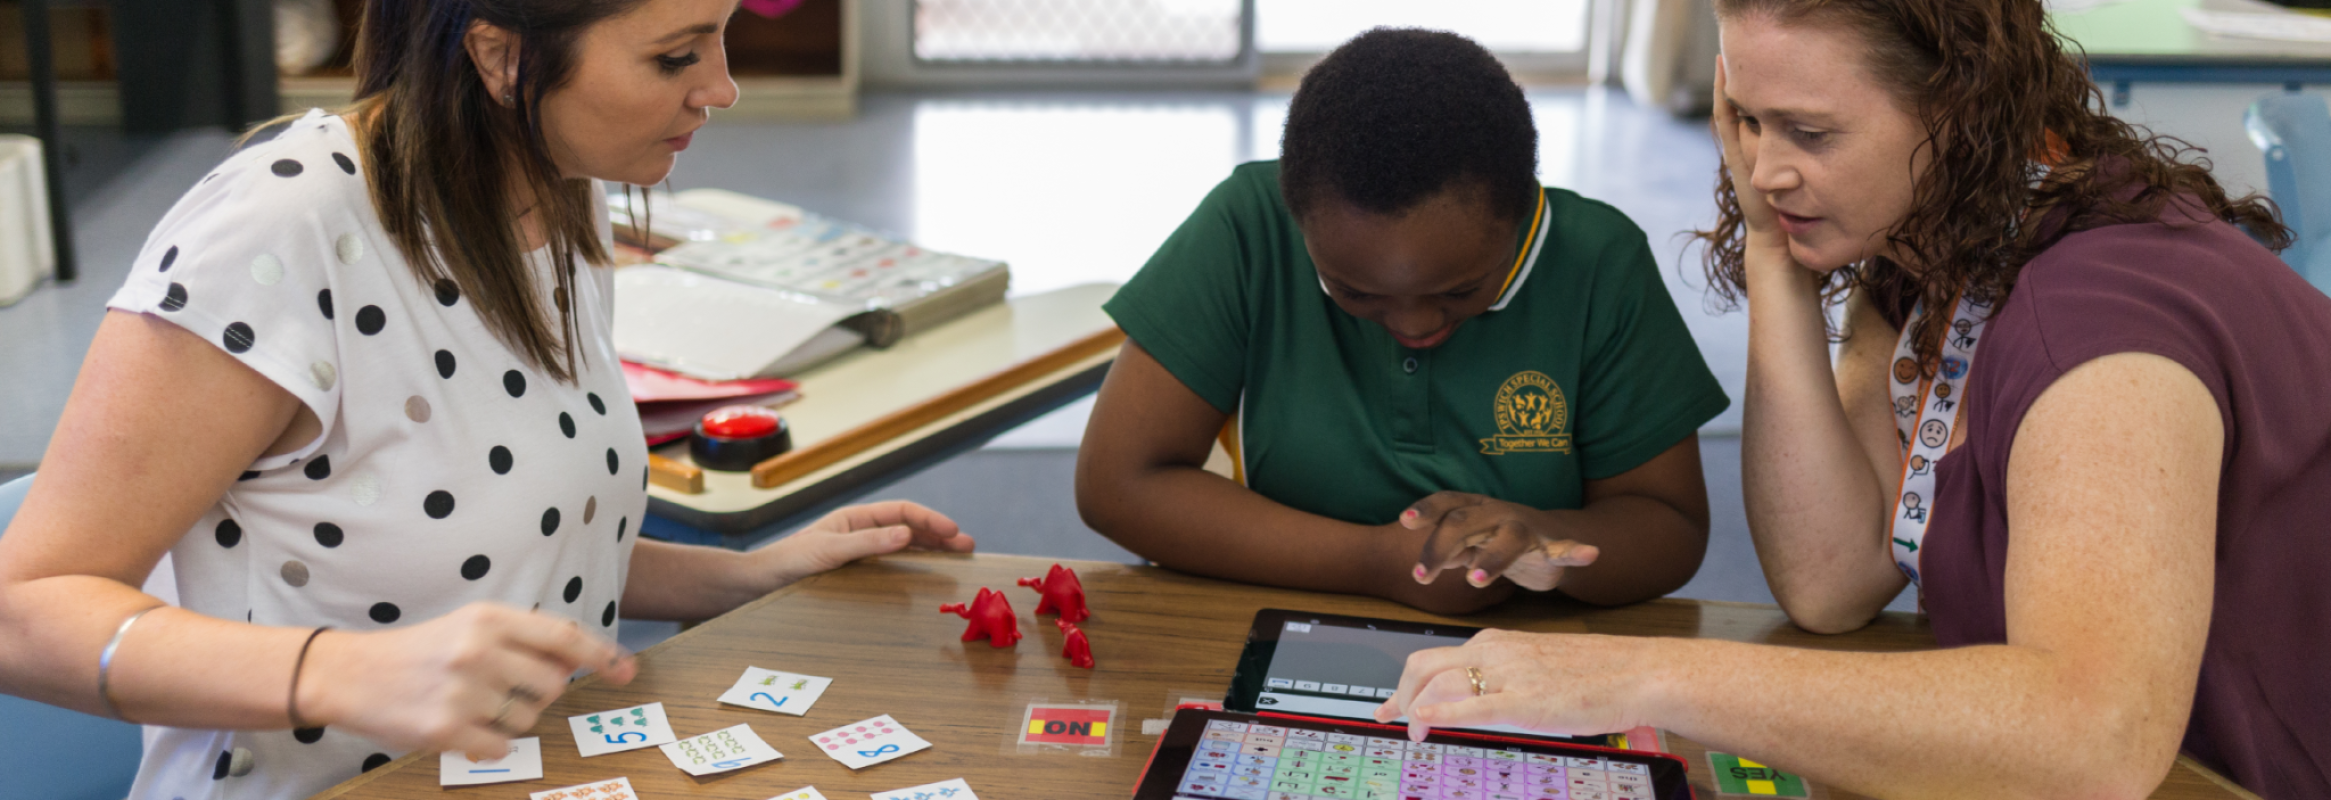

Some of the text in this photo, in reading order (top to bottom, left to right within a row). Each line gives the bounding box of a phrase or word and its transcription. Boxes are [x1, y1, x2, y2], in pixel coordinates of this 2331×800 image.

[1499, 438, 1568, 449] Together We Can
[749, 692, 789, 707] 2
[1044, 720, 1091, 736] NO
[604, 731, 647, 744] 5
[857, 744, 900, 758] 8
[711, 757, 752, 769] 9
[1730, 767, 1786, 781] YES
